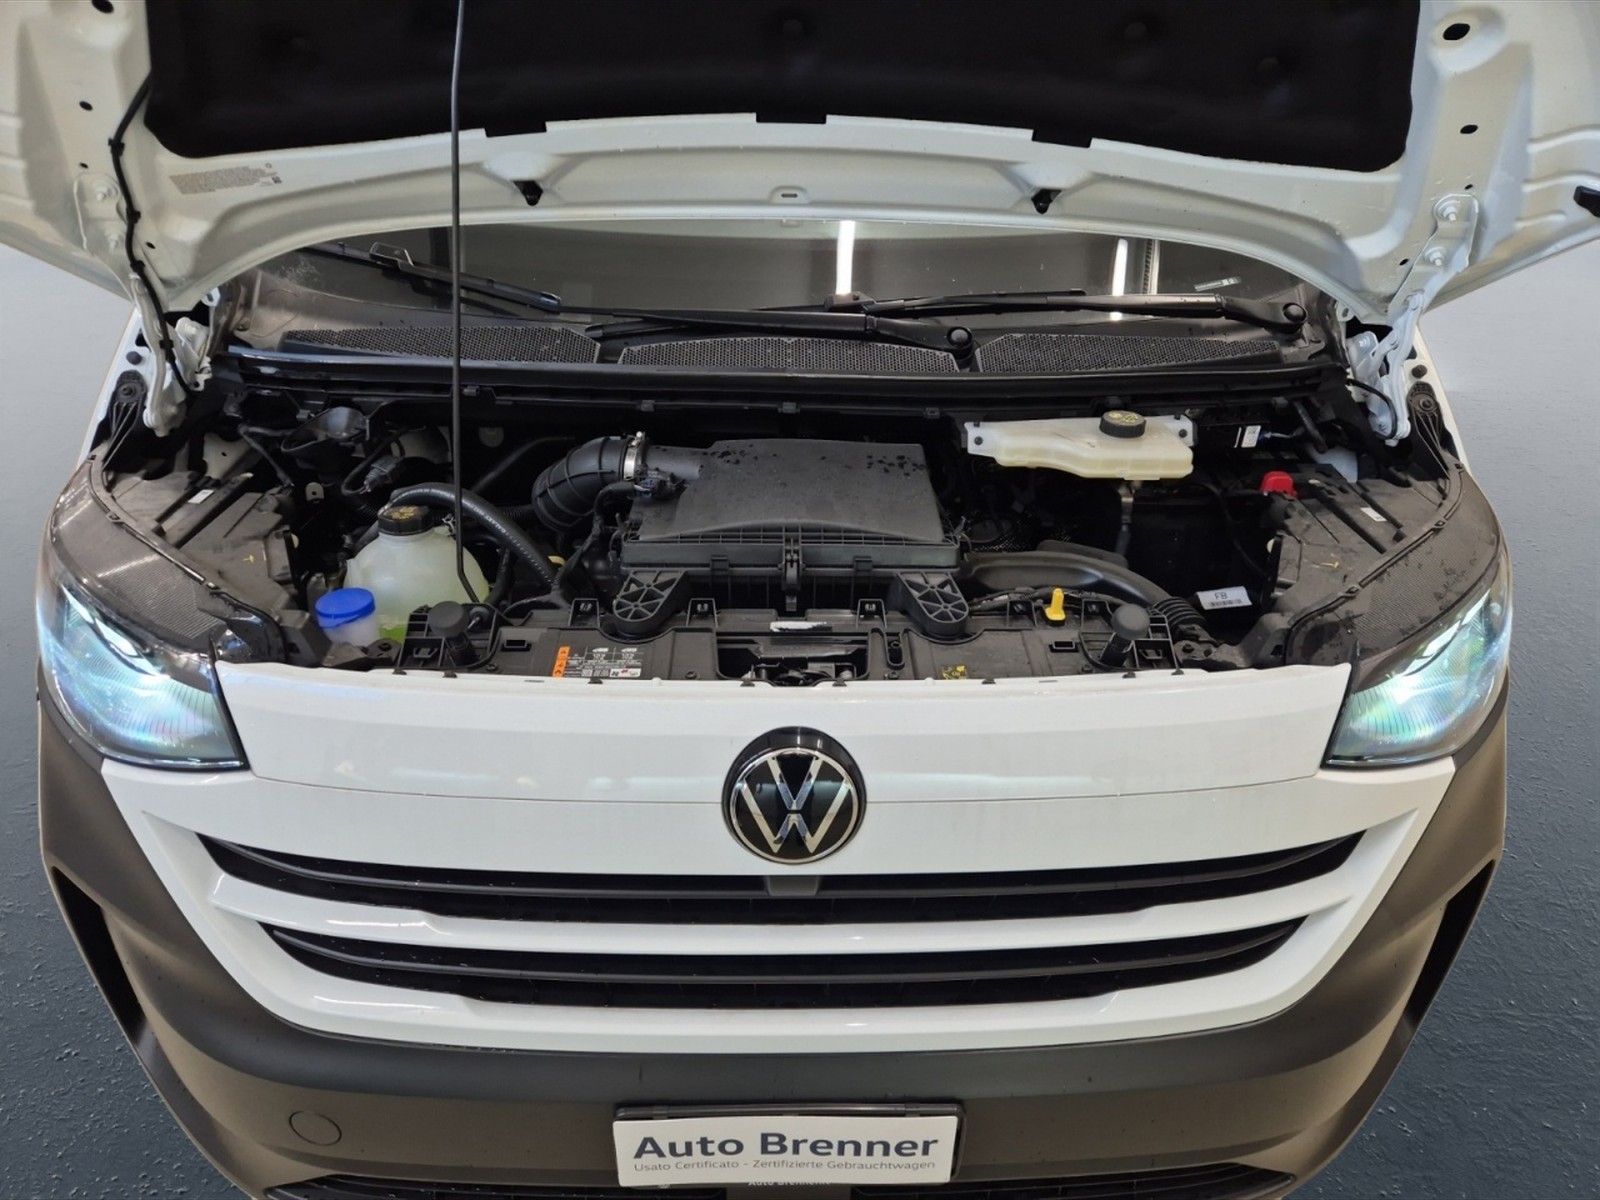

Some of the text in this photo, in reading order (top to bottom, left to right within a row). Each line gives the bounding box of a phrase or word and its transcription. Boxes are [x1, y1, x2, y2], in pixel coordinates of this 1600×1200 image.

[633, 1132, 938, 1159] Auto Brenner
[633, 1162, 671, 1172] Usato
[675, 1160, 740, 1170] Certificato
[752, 1159, 823, 1169] Zertifizierte
[826, 1160, 936, 1171] Gebrauchtwagen
